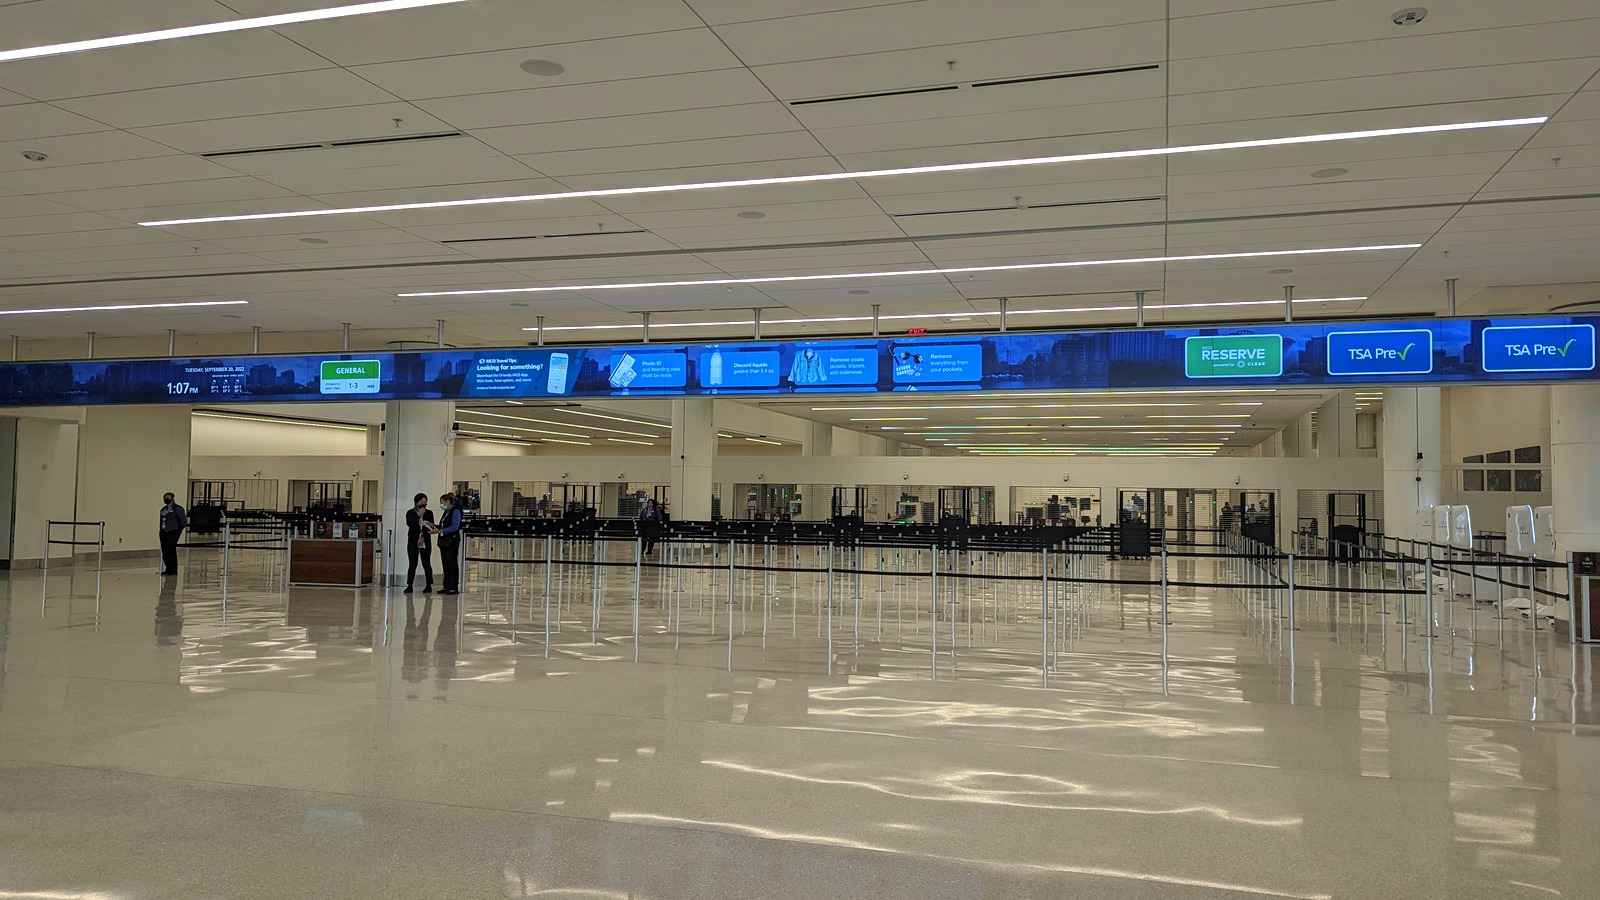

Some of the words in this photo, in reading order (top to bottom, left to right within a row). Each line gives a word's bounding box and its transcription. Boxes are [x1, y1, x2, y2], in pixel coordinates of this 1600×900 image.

[1202, 348, 1266, 360] RESERVE
[1348, 348, 1372, 360] TSA
[1376, 348, 1396, 359] Pre
[1505, 344, 1531, 356] TSA
[1534, 344, 1556, 355] Pre
[166, 382, 189, 394] 1:07
